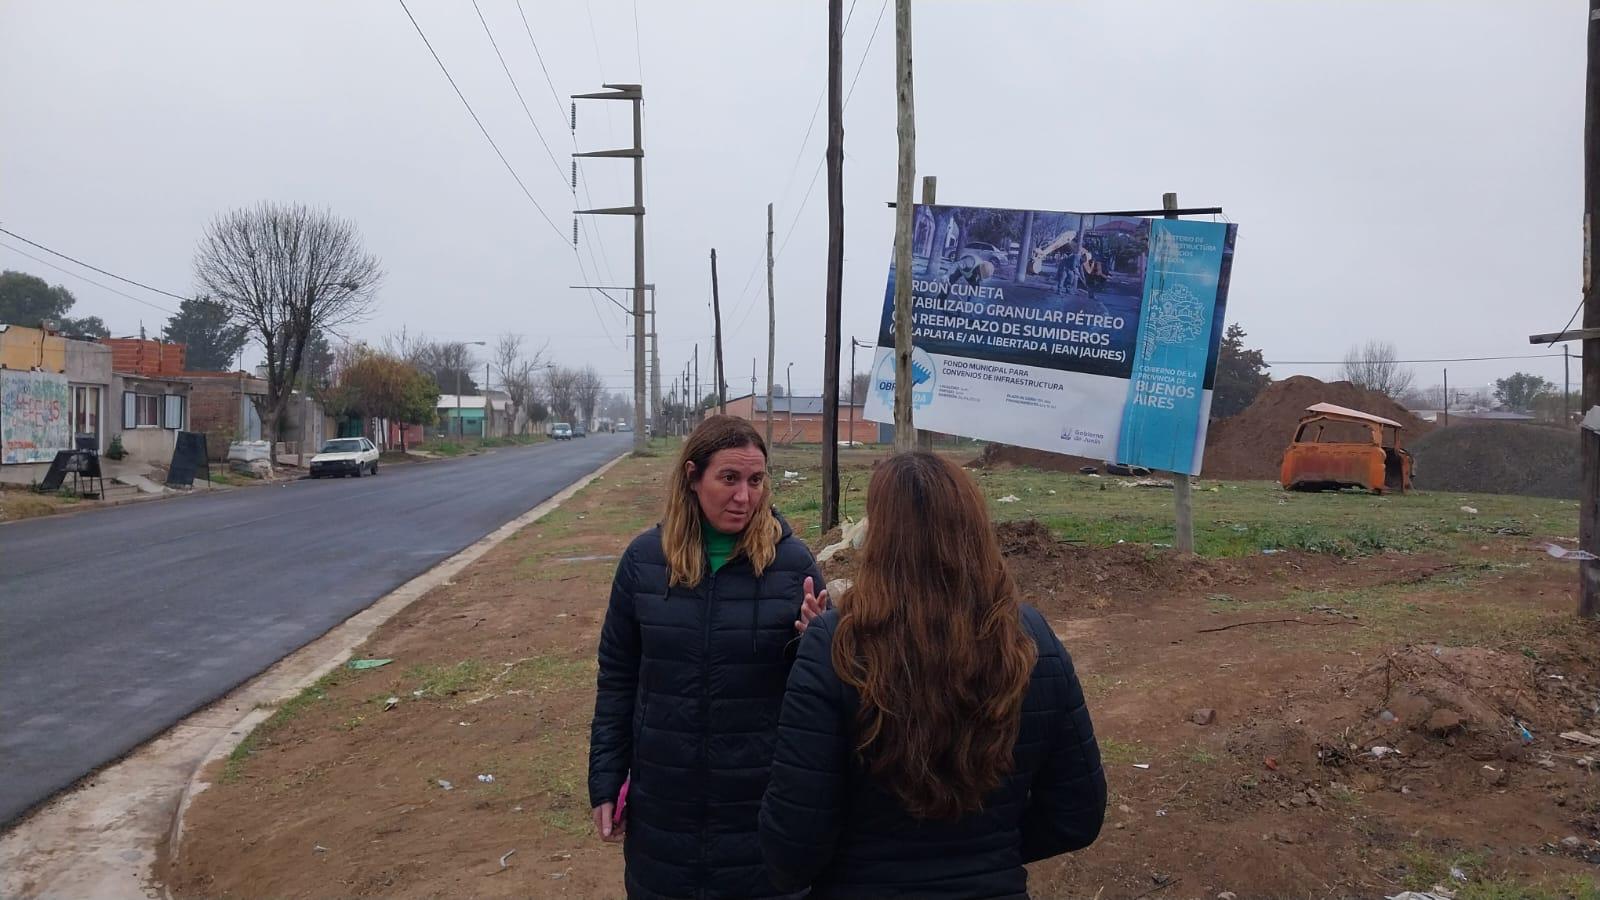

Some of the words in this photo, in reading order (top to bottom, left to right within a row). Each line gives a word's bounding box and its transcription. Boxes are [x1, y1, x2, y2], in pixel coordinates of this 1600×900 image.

[911, 279, 948, 294] RDÓN
[950, 283, 1004, 299] CUNETA
[986, 303, 1062, 323] GRANULAR
[1065, 310, 1125, 329] PÉTREO
[920, 313, 999, 333] REEMPLAZO
[1002, 322, 1021, 336] DE
[1023, 325, 1110, 346] SUMIDEROS
[923, 328, 955, 340] PLATA
[956, 332, 967, 343] E/
[968, 333, 985, 344] AV.
[987, 336, 1038, 351] LIBERTAD
[1039, 342, 1048, 352] A
[1051, 343, 1078, 356] JEAN
[1079, 346, 1126, 363] JAURES)
[943, 359, 968, 369] FONDO
[968, 363, 1008, 374] MUNICIPAL
[1008, 368, 1029, 377] PARA
[1176, 369, 1187, 377] DE
[1188, 371, 1197, 379] LA
[942, 367, 981, 380] CONVENIOS
[982, 373, 993, 381] DE
[993, 374, 1064, 391] INFRAESTRUCTURA
[1137, 372, 1175, 384] PROVINCIA
[1176, 377, 1187, 385] DE
[1135, 380, 1196, 399] BUENOS
[1132, 393, 1175, 410] AIRES
